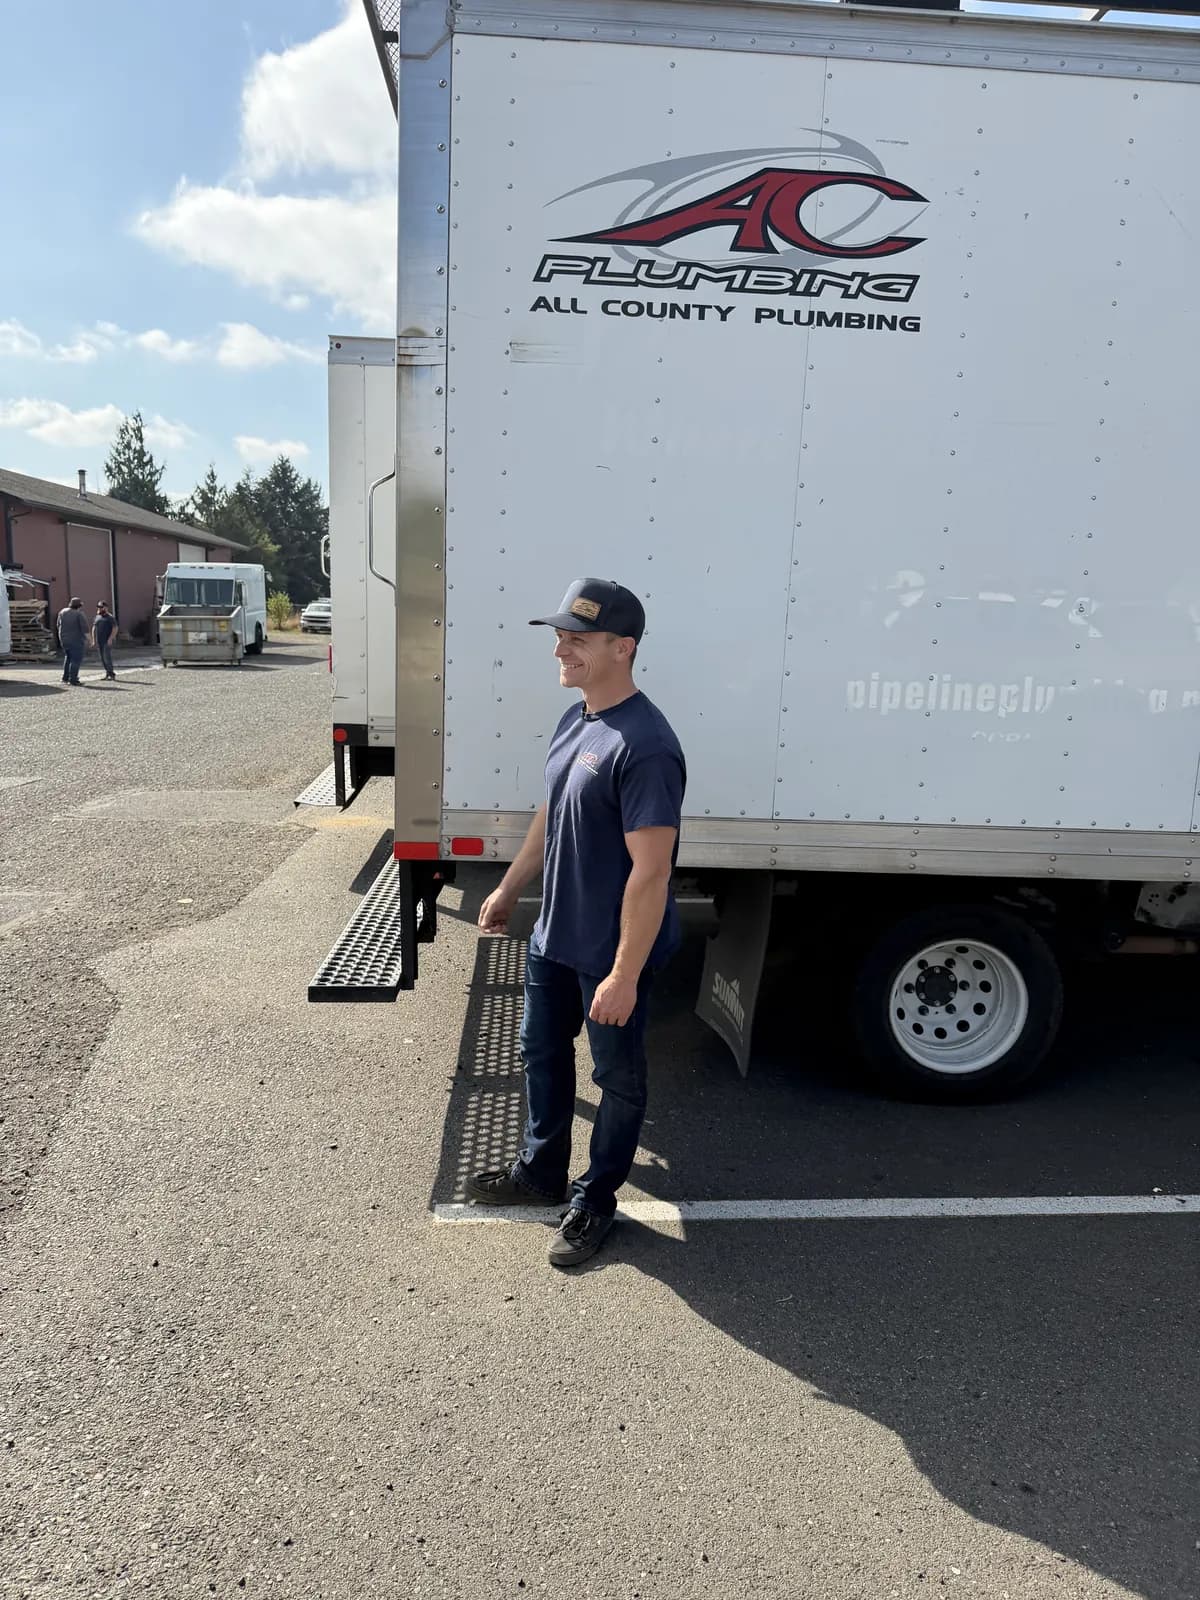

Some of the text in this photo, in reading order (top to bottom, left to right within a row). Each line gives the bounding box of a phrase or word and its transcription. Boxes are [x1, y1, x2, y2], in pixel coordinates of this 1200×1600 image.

[546, 167, 931, 259] AC
[532, 254, 921, 303] PLUMBING
[529, 296, 922, 333] ALL COUNTY PLUMBING
